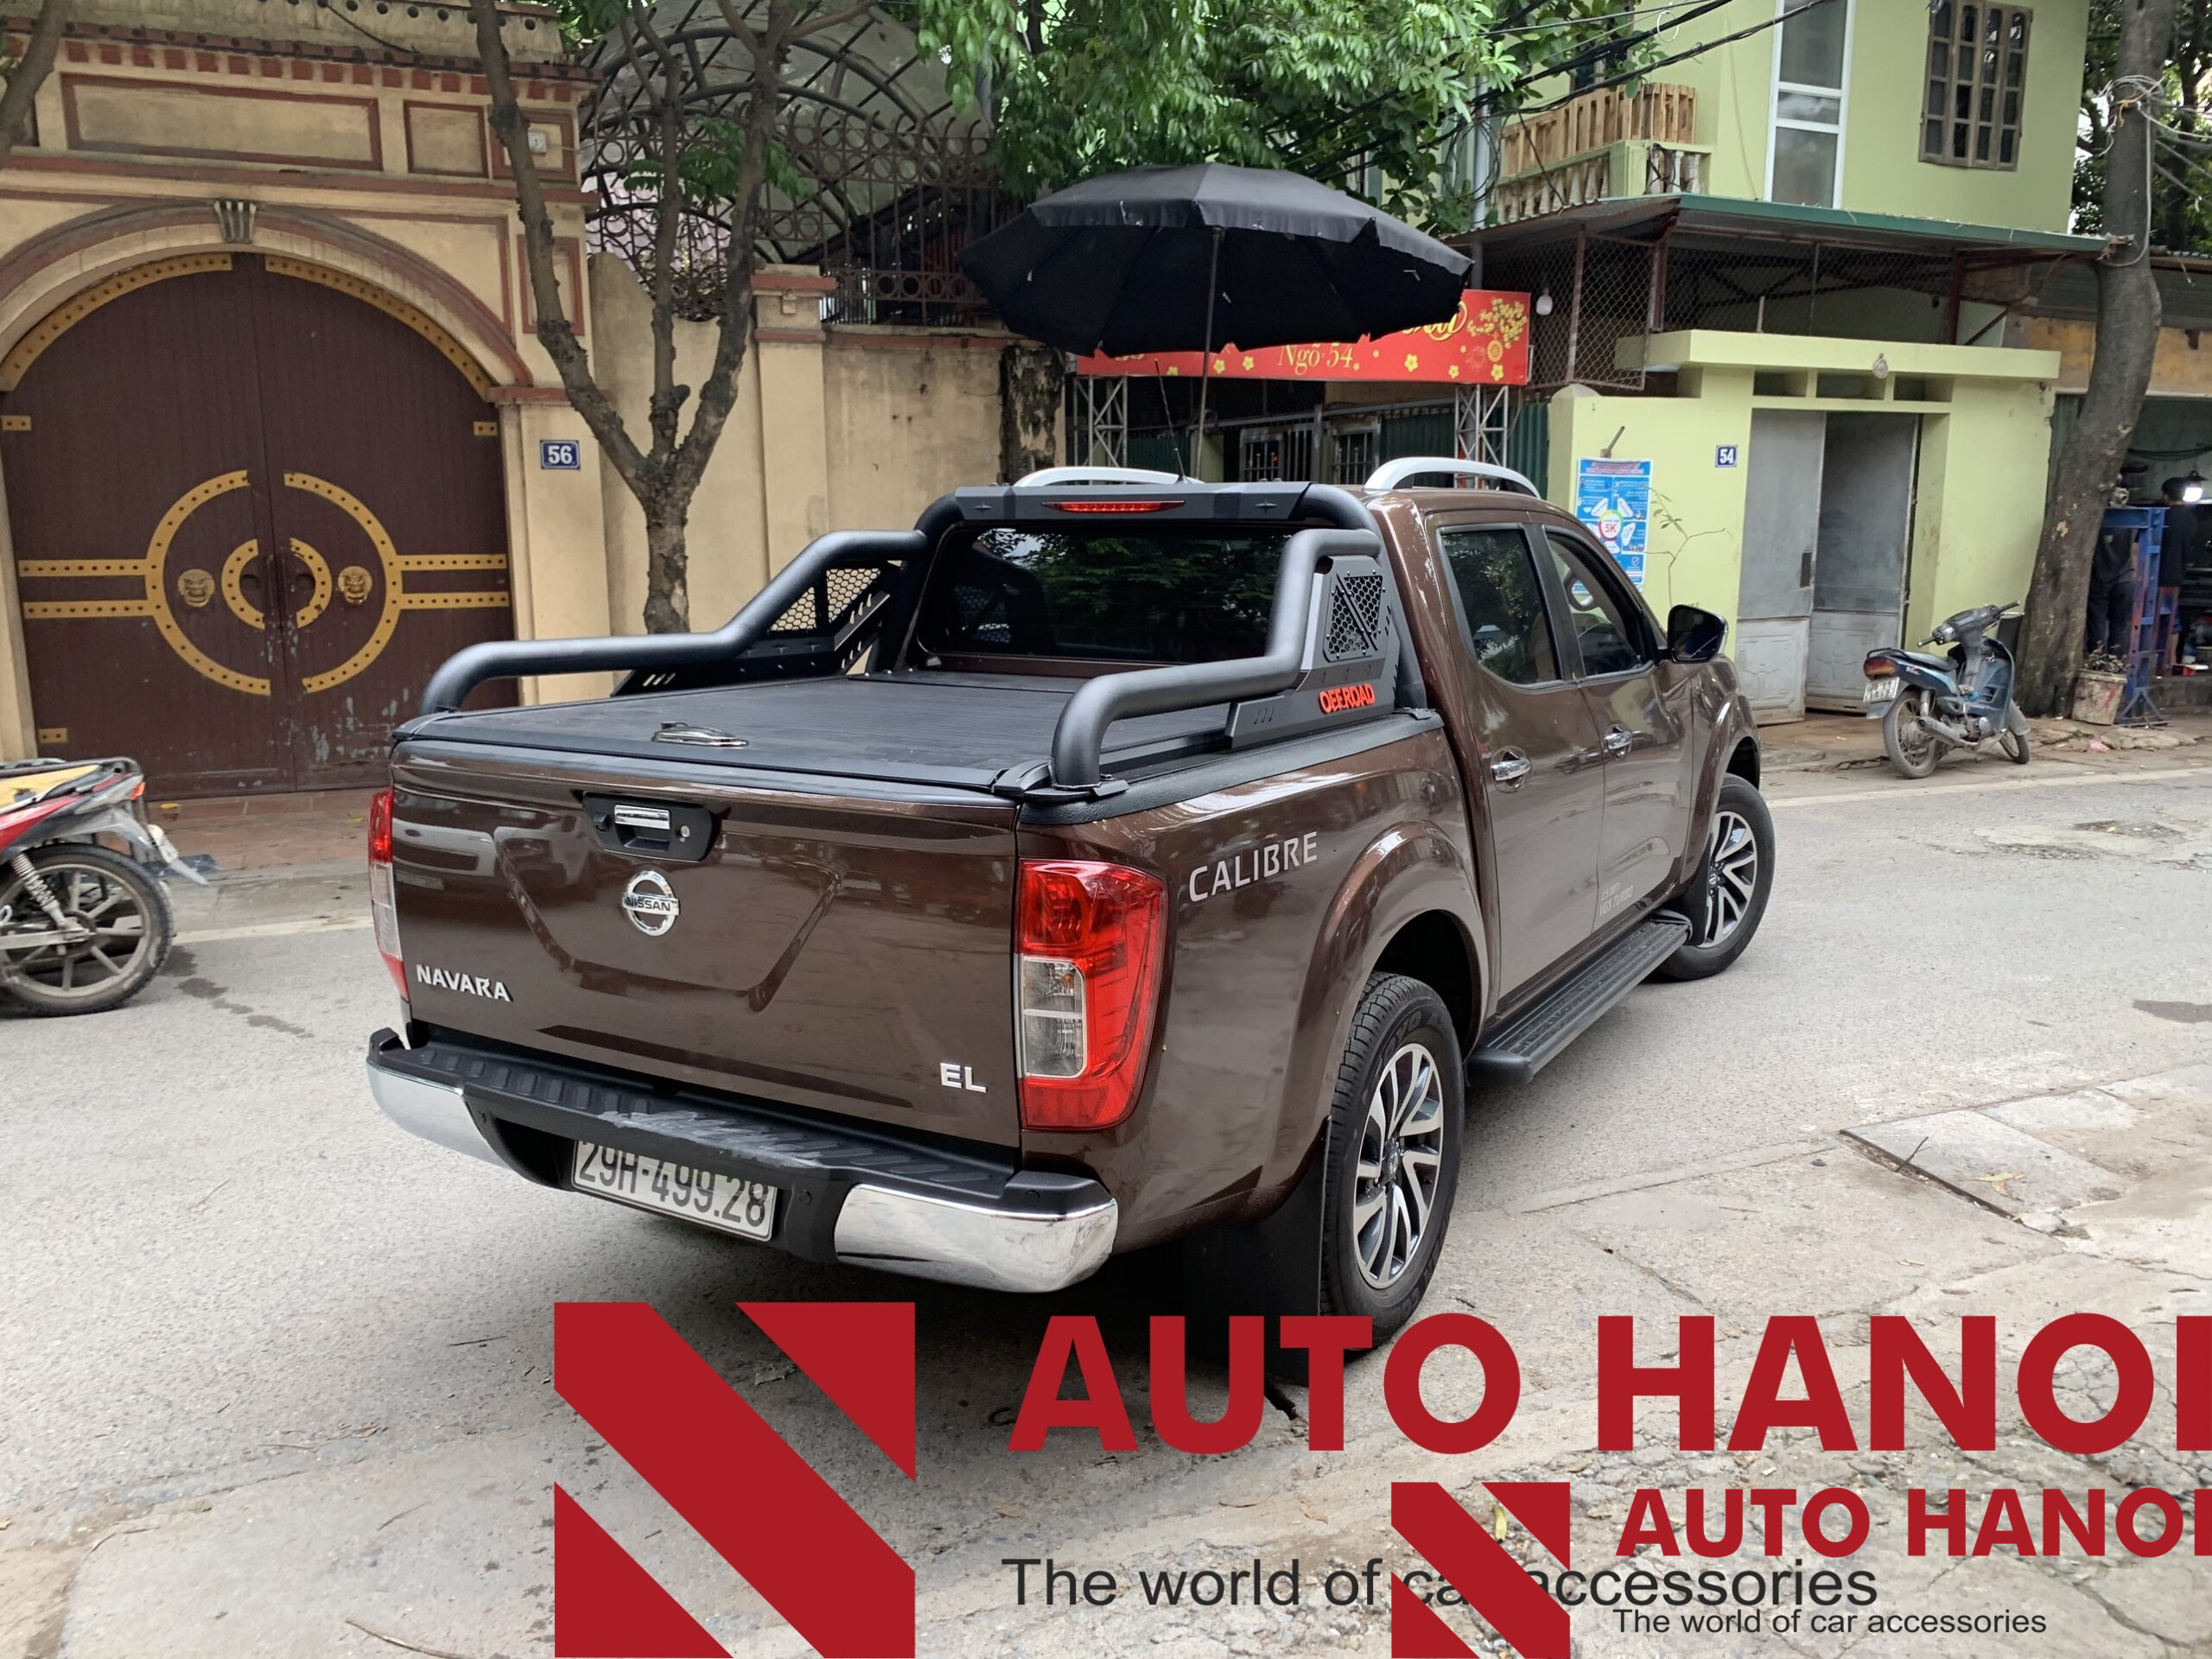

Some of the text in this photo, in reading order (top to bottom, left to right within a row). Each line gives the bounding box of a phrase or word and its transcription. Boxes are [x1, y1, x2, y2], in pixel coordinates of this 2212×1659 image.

[1277, 343, 1321, 376] Ngõ
[548, 445, 573, 465] 56
[1719, 448, 1734, 464] 54
[1605, 524, 1618, 532] 5K
[1189, 830, 1318, 902] CALIBRE
[624, 896, 671, 912] NISSAN
[416, 963, 512, 1002] NAVARA
[939, 1062, 987, 1094] EL
[578, 1140, 769, 1227] 29H-499.28
